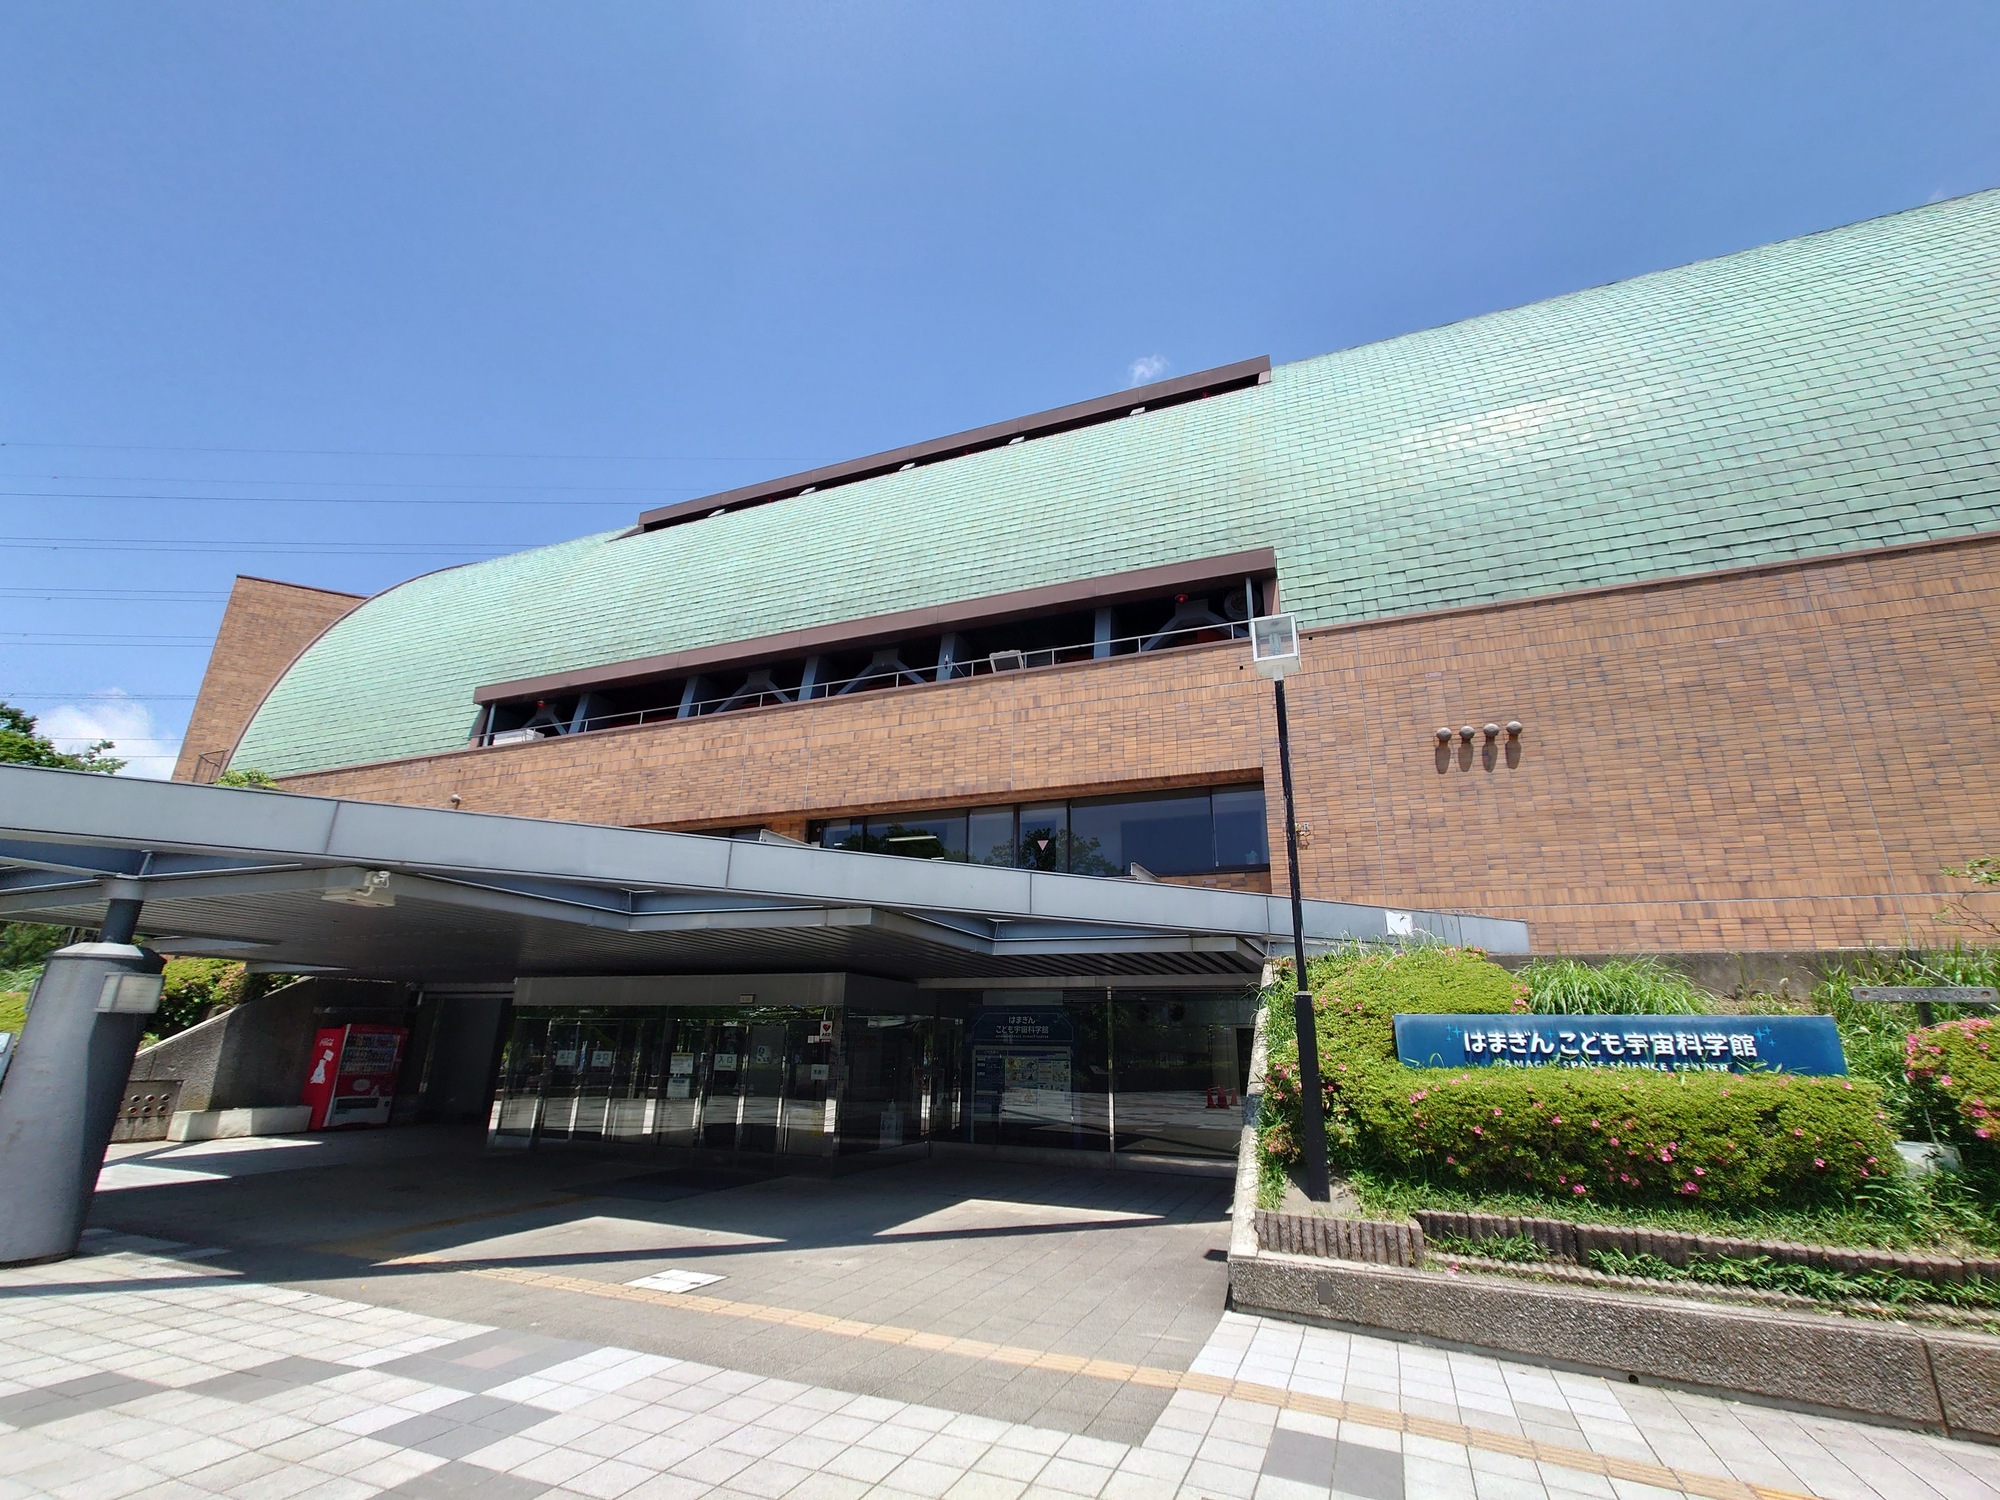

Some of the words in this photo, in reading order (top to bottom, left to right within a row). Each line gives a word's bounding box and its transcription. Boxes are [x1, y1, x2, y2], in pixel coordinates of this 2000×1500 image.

[1008, 1016, 1036, 1024] はまぎん
[995, 1025, 1049, 1034] こども宇宙科学館
[1464, 1031, 1555, 1054] はまぎん
[1559, 1031, 1757, 1057] こども宇宙科学館
[718, 1055, 733, 1064] 入口
